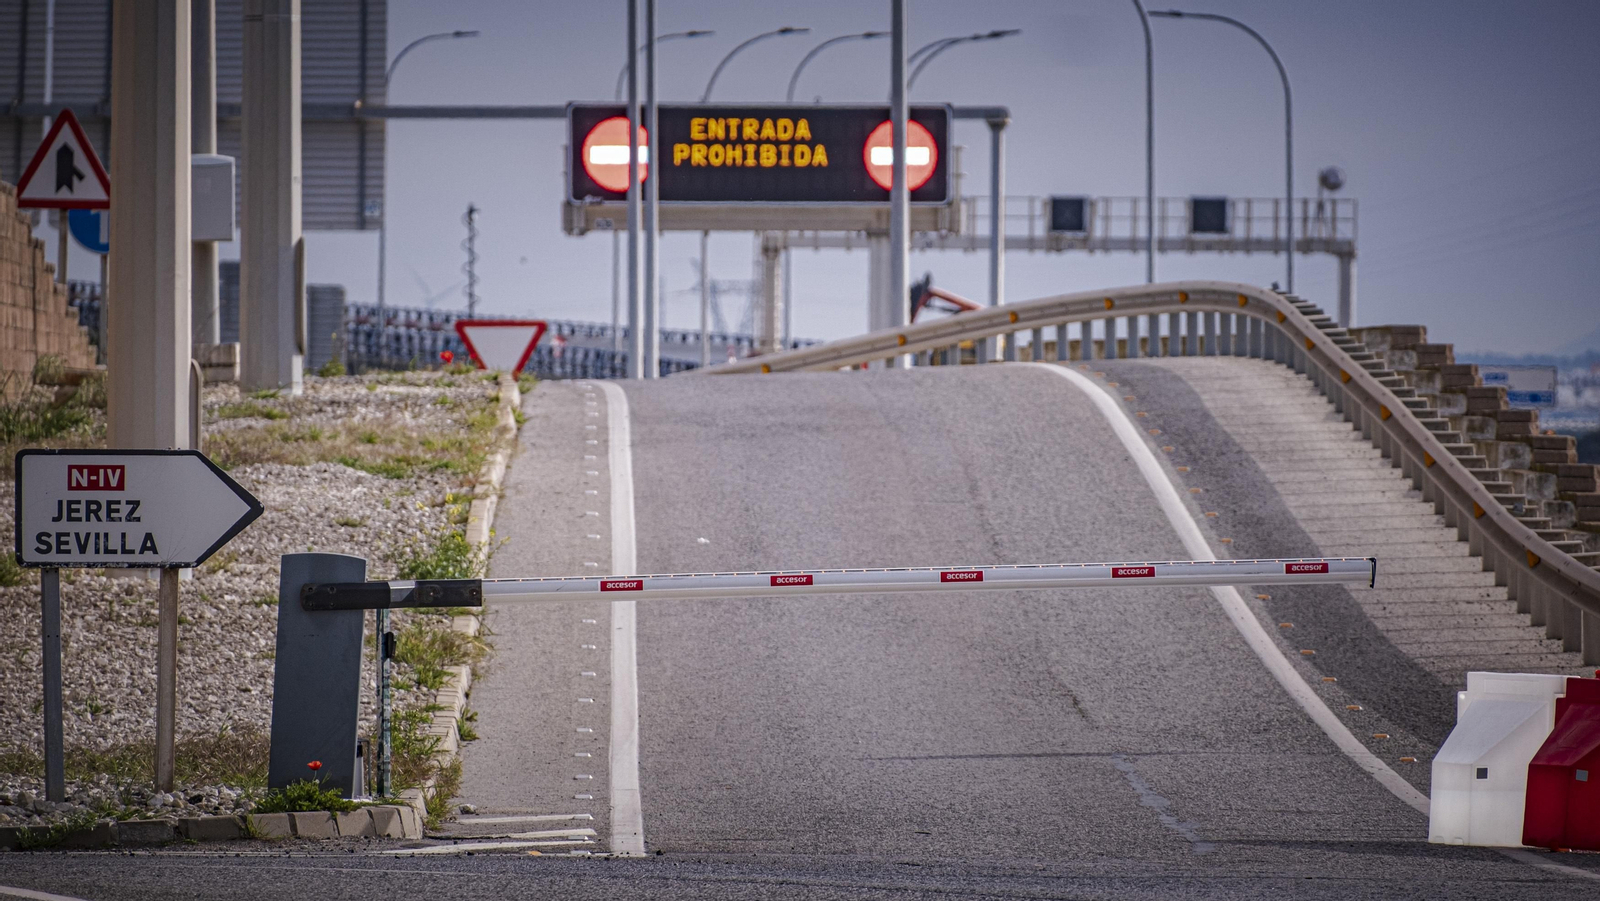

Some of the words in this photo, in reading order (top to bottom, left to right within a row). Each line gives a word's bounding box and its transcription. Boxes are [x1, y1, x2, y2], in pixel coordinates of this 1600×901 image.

[690, 117, 811, 141] ENTRADA
[673, 143, 829, 167] PROHIBIDA
[71, 468, 121, 487] N-IV
[51, 499, 141, 522] JEREZ
[34, 531, 159, 555] SEVILLA
[1117, 568, 1149, 576] accesor
[1291, 564, 1322, 572] accesor
[776, 576, 808, 584] accesor
[946, 572, 977, 580] accesor
[606, 581, 637, 589] accesor
